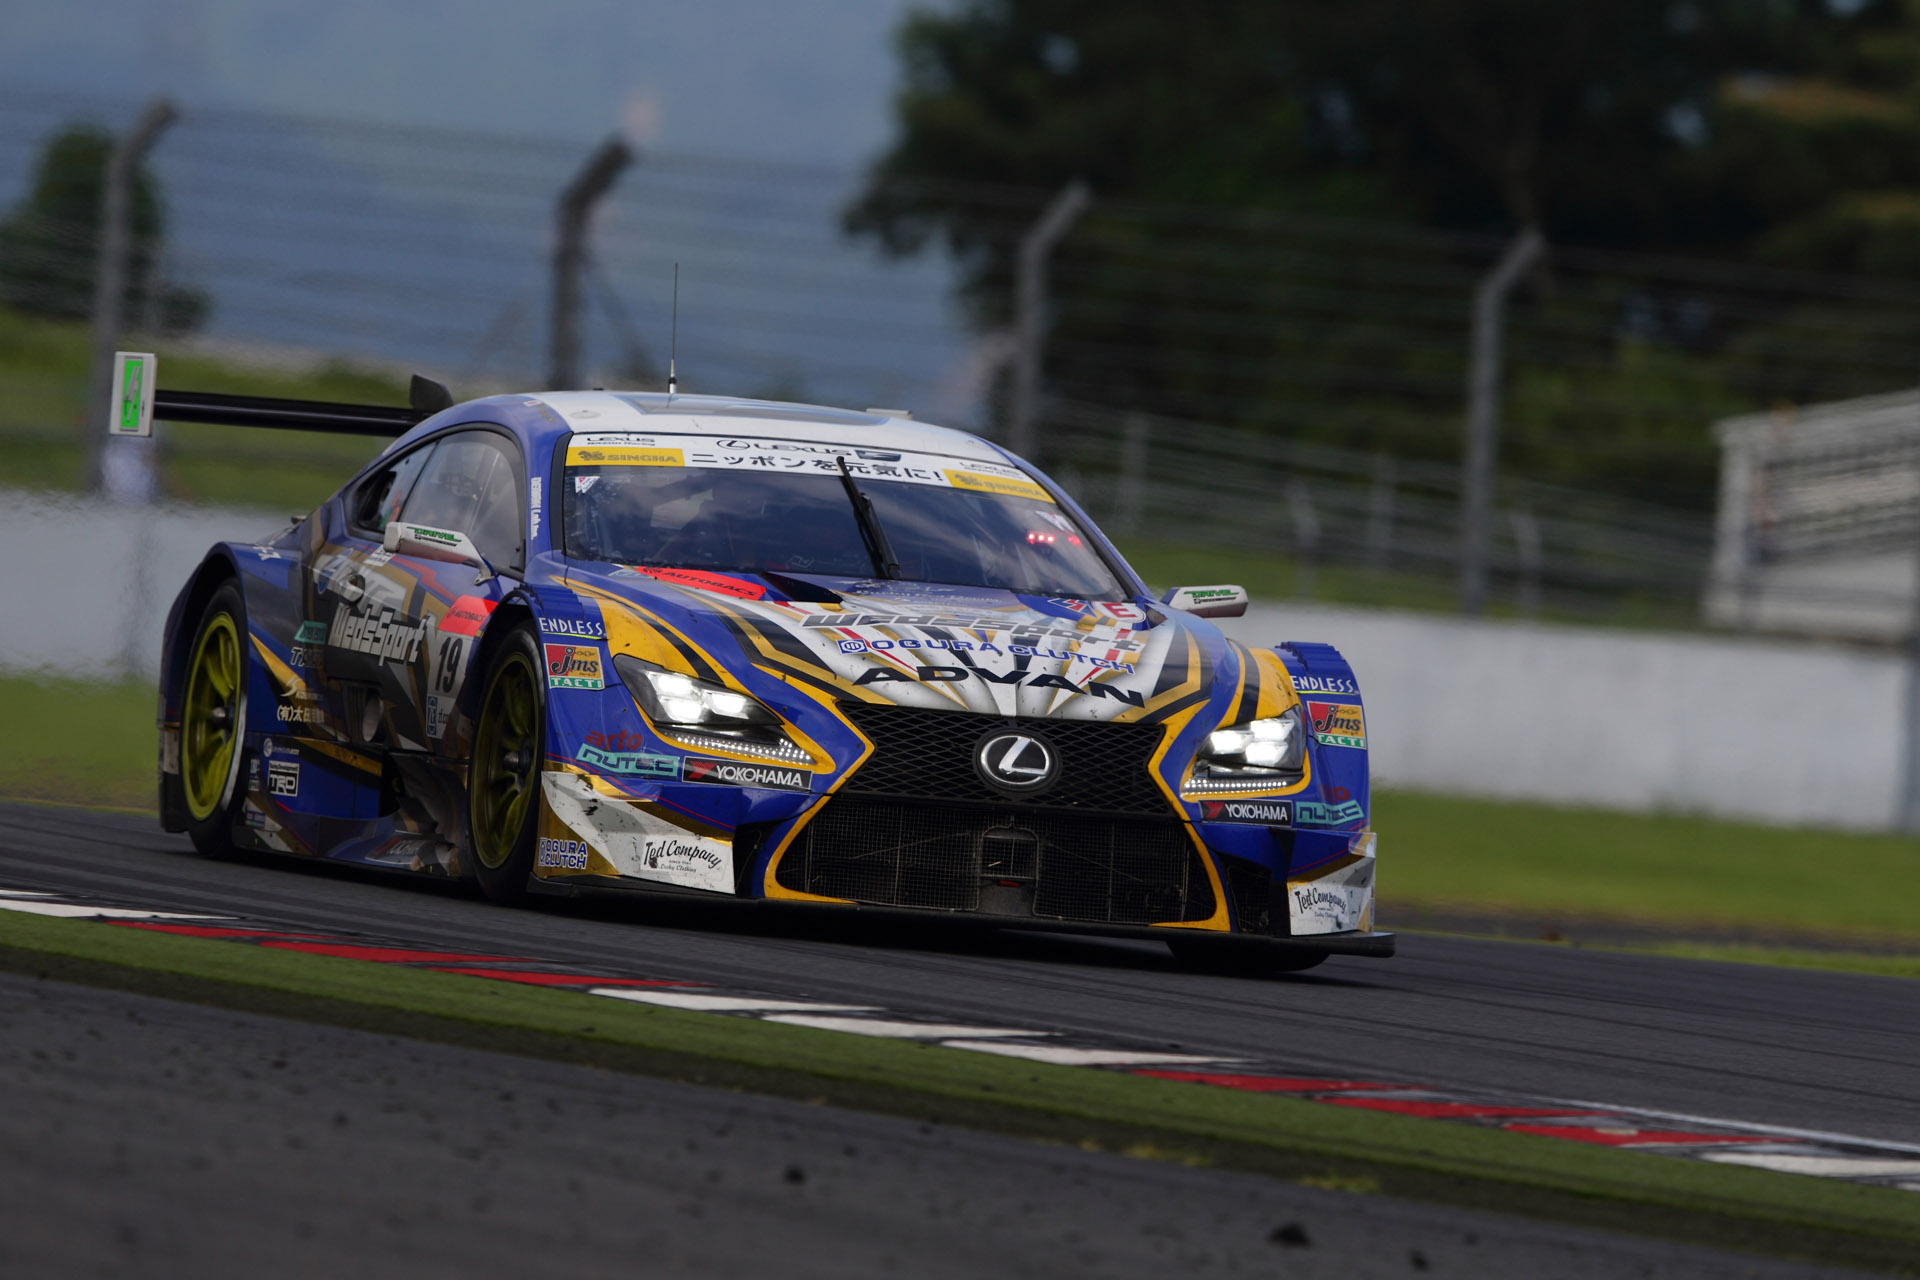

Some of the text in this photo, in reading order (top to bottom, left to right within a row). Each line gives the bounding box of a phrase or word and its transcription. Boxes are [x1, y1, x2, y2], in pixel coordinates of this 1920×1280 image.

[606, 454, 678, 463] SINGHA
[754, 443, 852, 456] LEXUS
[664, 571, 757, 597] AUTOBACS
[538, 617, 603, 636] ENDLESS
[438, 636, 464, 694] 19
[871, 638, 1136, 675] OGURA CLUTCH
[550, 677, 603, 688] TACTI
[851, 665, 1146, 709] ADVAN
[1289, 675, 1354, 693] ENDLESS
[584, 728, 643, 751] arto
[1316, 733, 1365, 747] TACTI
[269, 774, 296, 794] TRD
[716, 765, 803, 787] YOKOHAMA
[1224, 803, 1288, 821] YOKOHAMA
[545, 839, 588, 855] OGURA
[643, 839, 722, 870] Ted Company
[544, 853, 587, 869] CLUTCH
[1294, 887, 1347, 914] Ted Company
